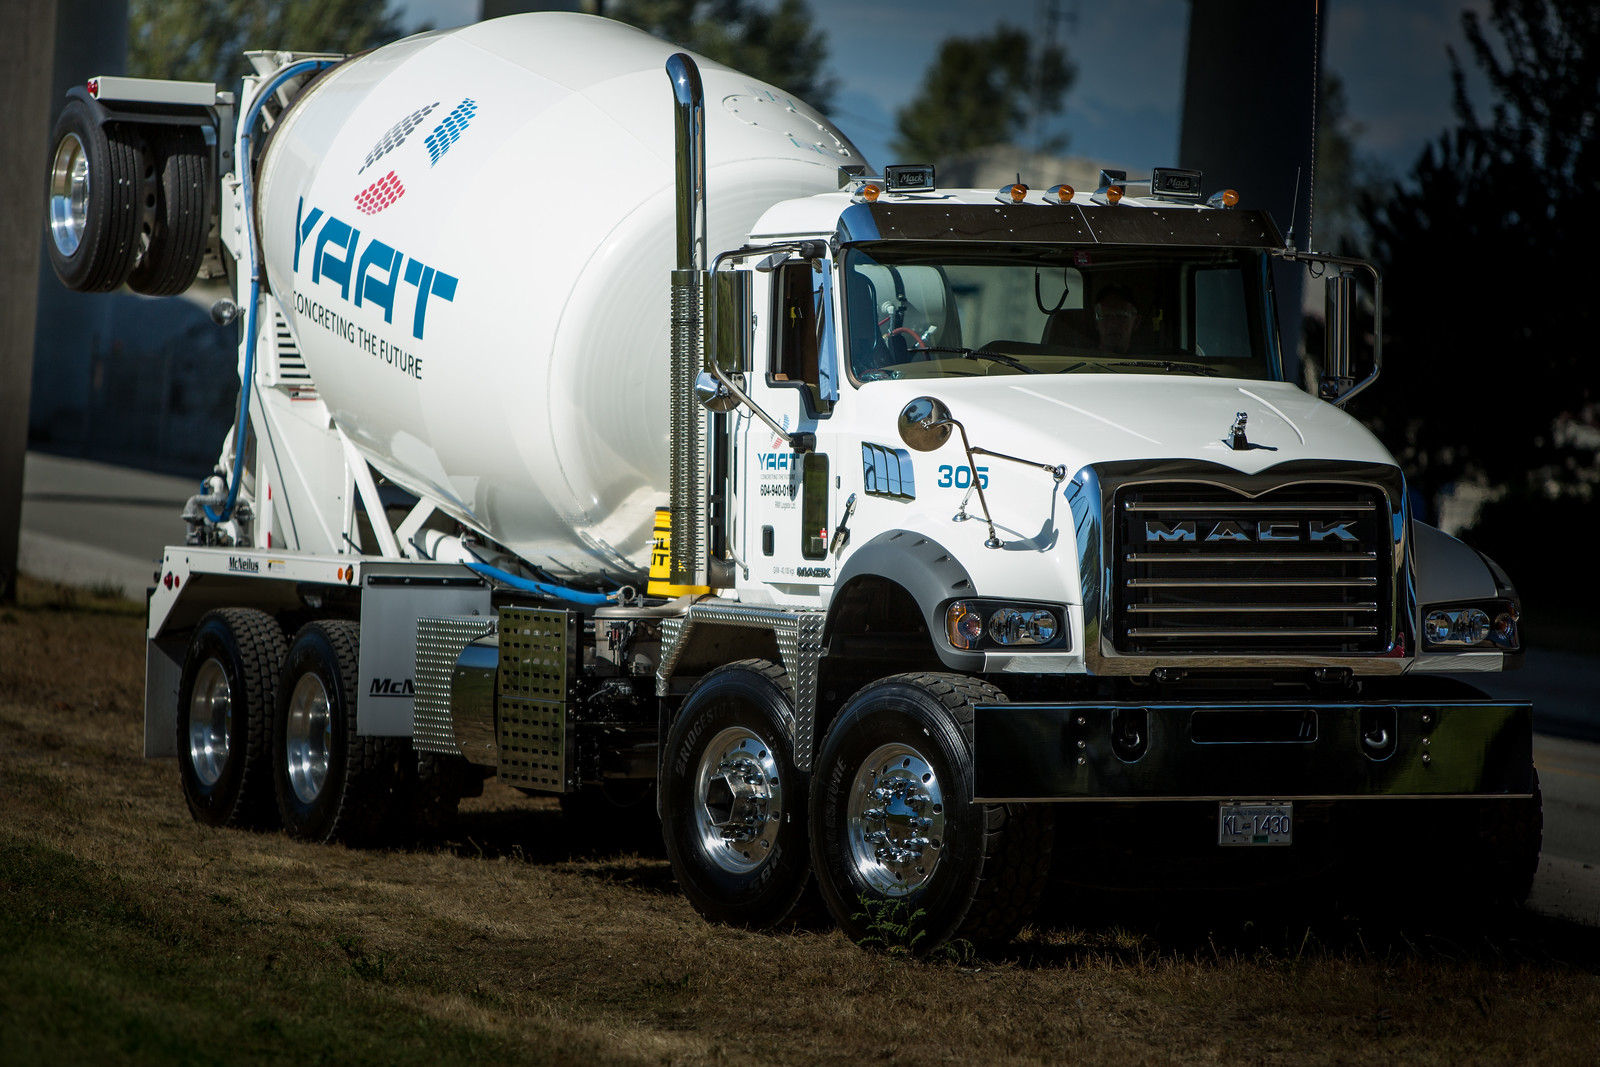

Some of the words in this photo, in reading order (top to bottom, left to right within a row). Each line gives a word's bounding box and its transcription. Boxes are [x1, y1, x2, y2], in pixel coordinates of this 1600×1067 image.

[899, 173, 924, 184] Mack
[1166, 177, 1190, 188] Mack
[293, 195, 459, 340] YAAT
[293, 291, 355, 344] CONCRETING
[357, 327, 377, 356] THE
[380, 339, 423, 380] FUTURE
[757, 453, 800, 471] YAAT
[937, 464, 989, 490] 305
[760, 484, 796, 497] 604-940-0191
[1145, 520, 1360, 542] MACK
[229, 556, 259, 572] McNeilus
[796, 566, 831, 578] MACK
[1222, 815, 1243, 835] KL
[1253, 815, 1290, 835] 1430
